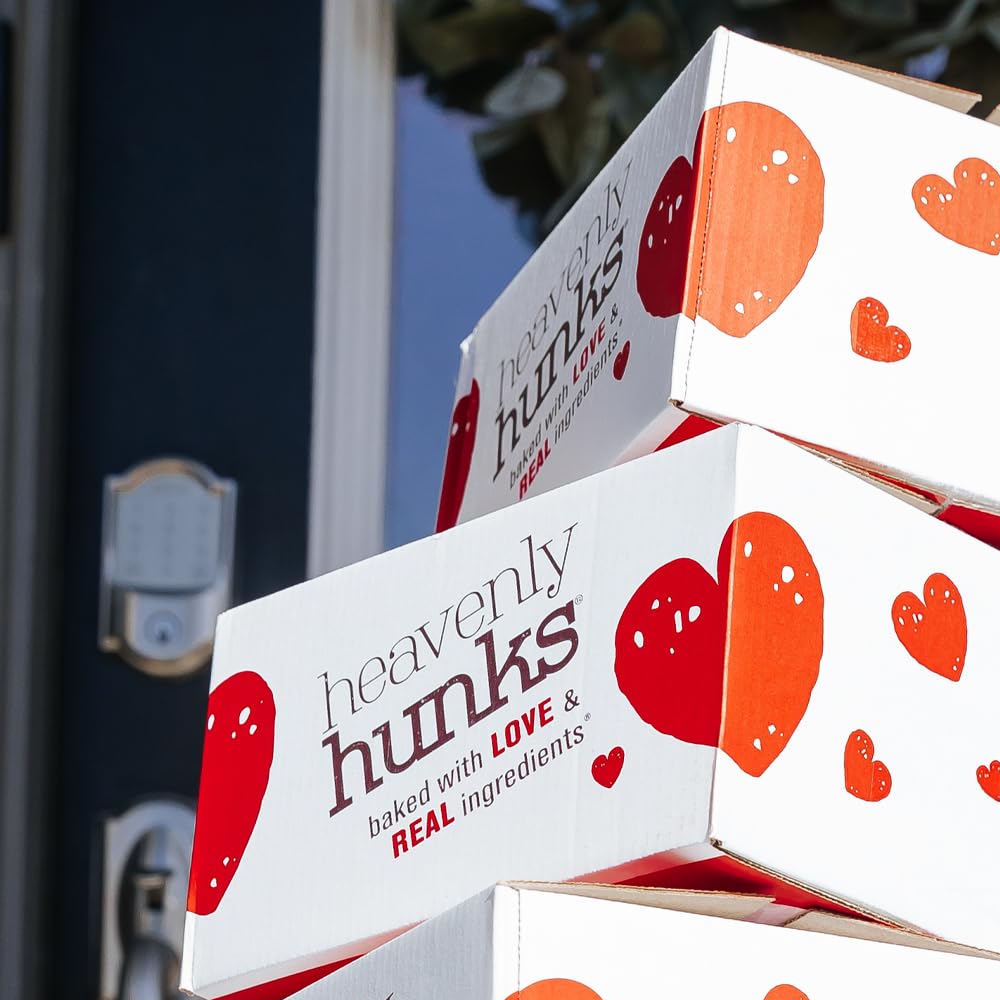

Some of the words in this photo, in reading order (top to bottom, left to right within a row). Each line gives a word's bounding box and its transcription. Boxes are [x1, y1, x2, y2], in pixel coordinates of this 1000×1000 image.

[498, 158, 633, 403] heavenly
[509, 429, 542, 489] baked
[544, 384, 570, 430] with
[572, 319, 607, 385] LOVE
[609, 303, 619, 326] &
[519, 438, 551, 500] REAL
[317, 522, 579, 735] heavenly
[369, 780, 431, 839] baked
[437, 750, 483, 793] with
[490, 697, 554, 758] LOVE
[564, 689, 580, 712] &
[391, 802, 455, 859] REAL
